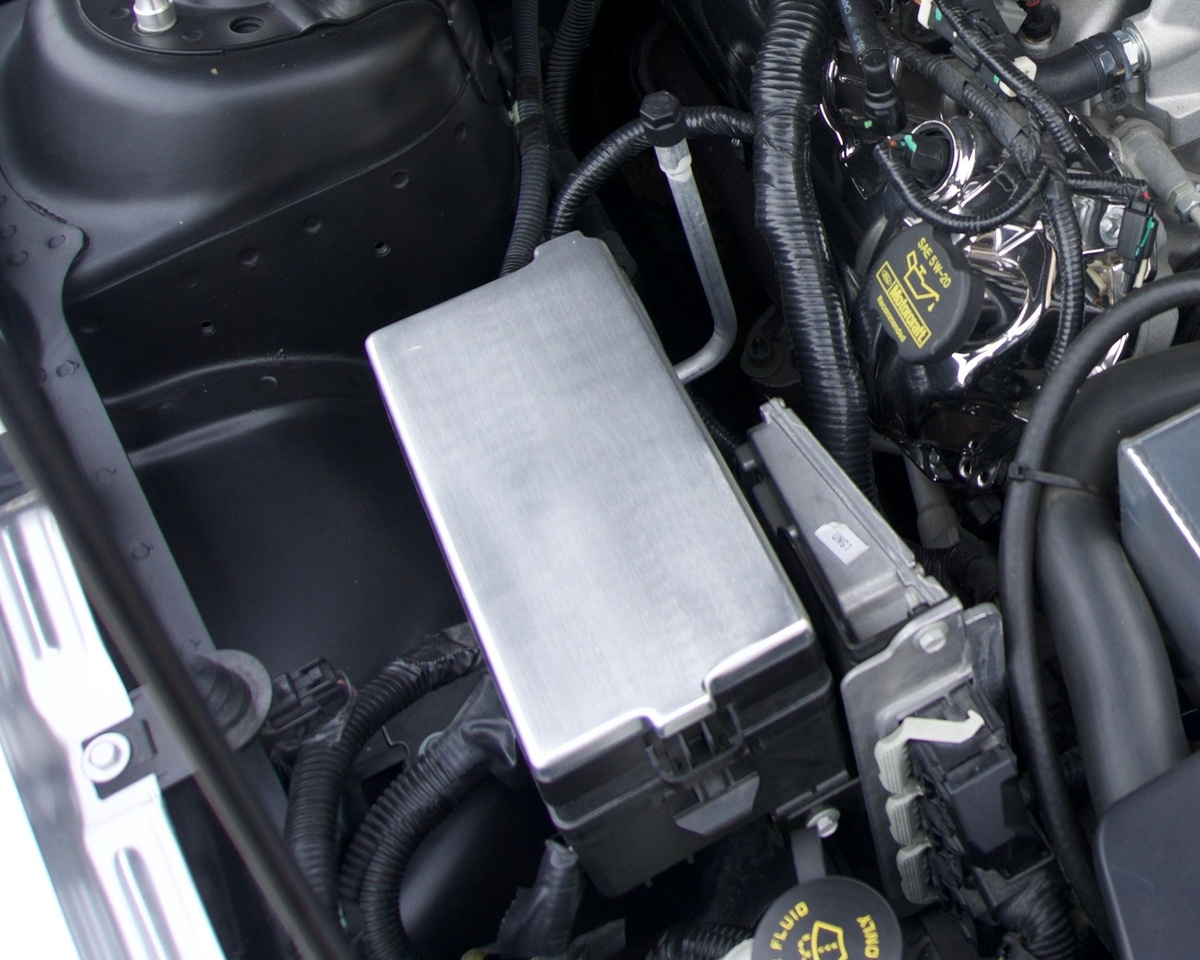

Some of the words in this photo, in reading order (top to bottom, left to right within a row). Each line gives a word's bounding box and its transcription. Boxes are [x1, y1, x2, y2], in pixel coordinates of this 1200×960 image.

[917, 237, 933, 259] SAE
[928, 255, 952, 289] 5W-20
[876, 294, 907, 343] Recommended
[888, 282, 930, 344] Motorcraft
[770, 901, 810, 951] FLUID
[856, 914, 881, 959] ONLY
